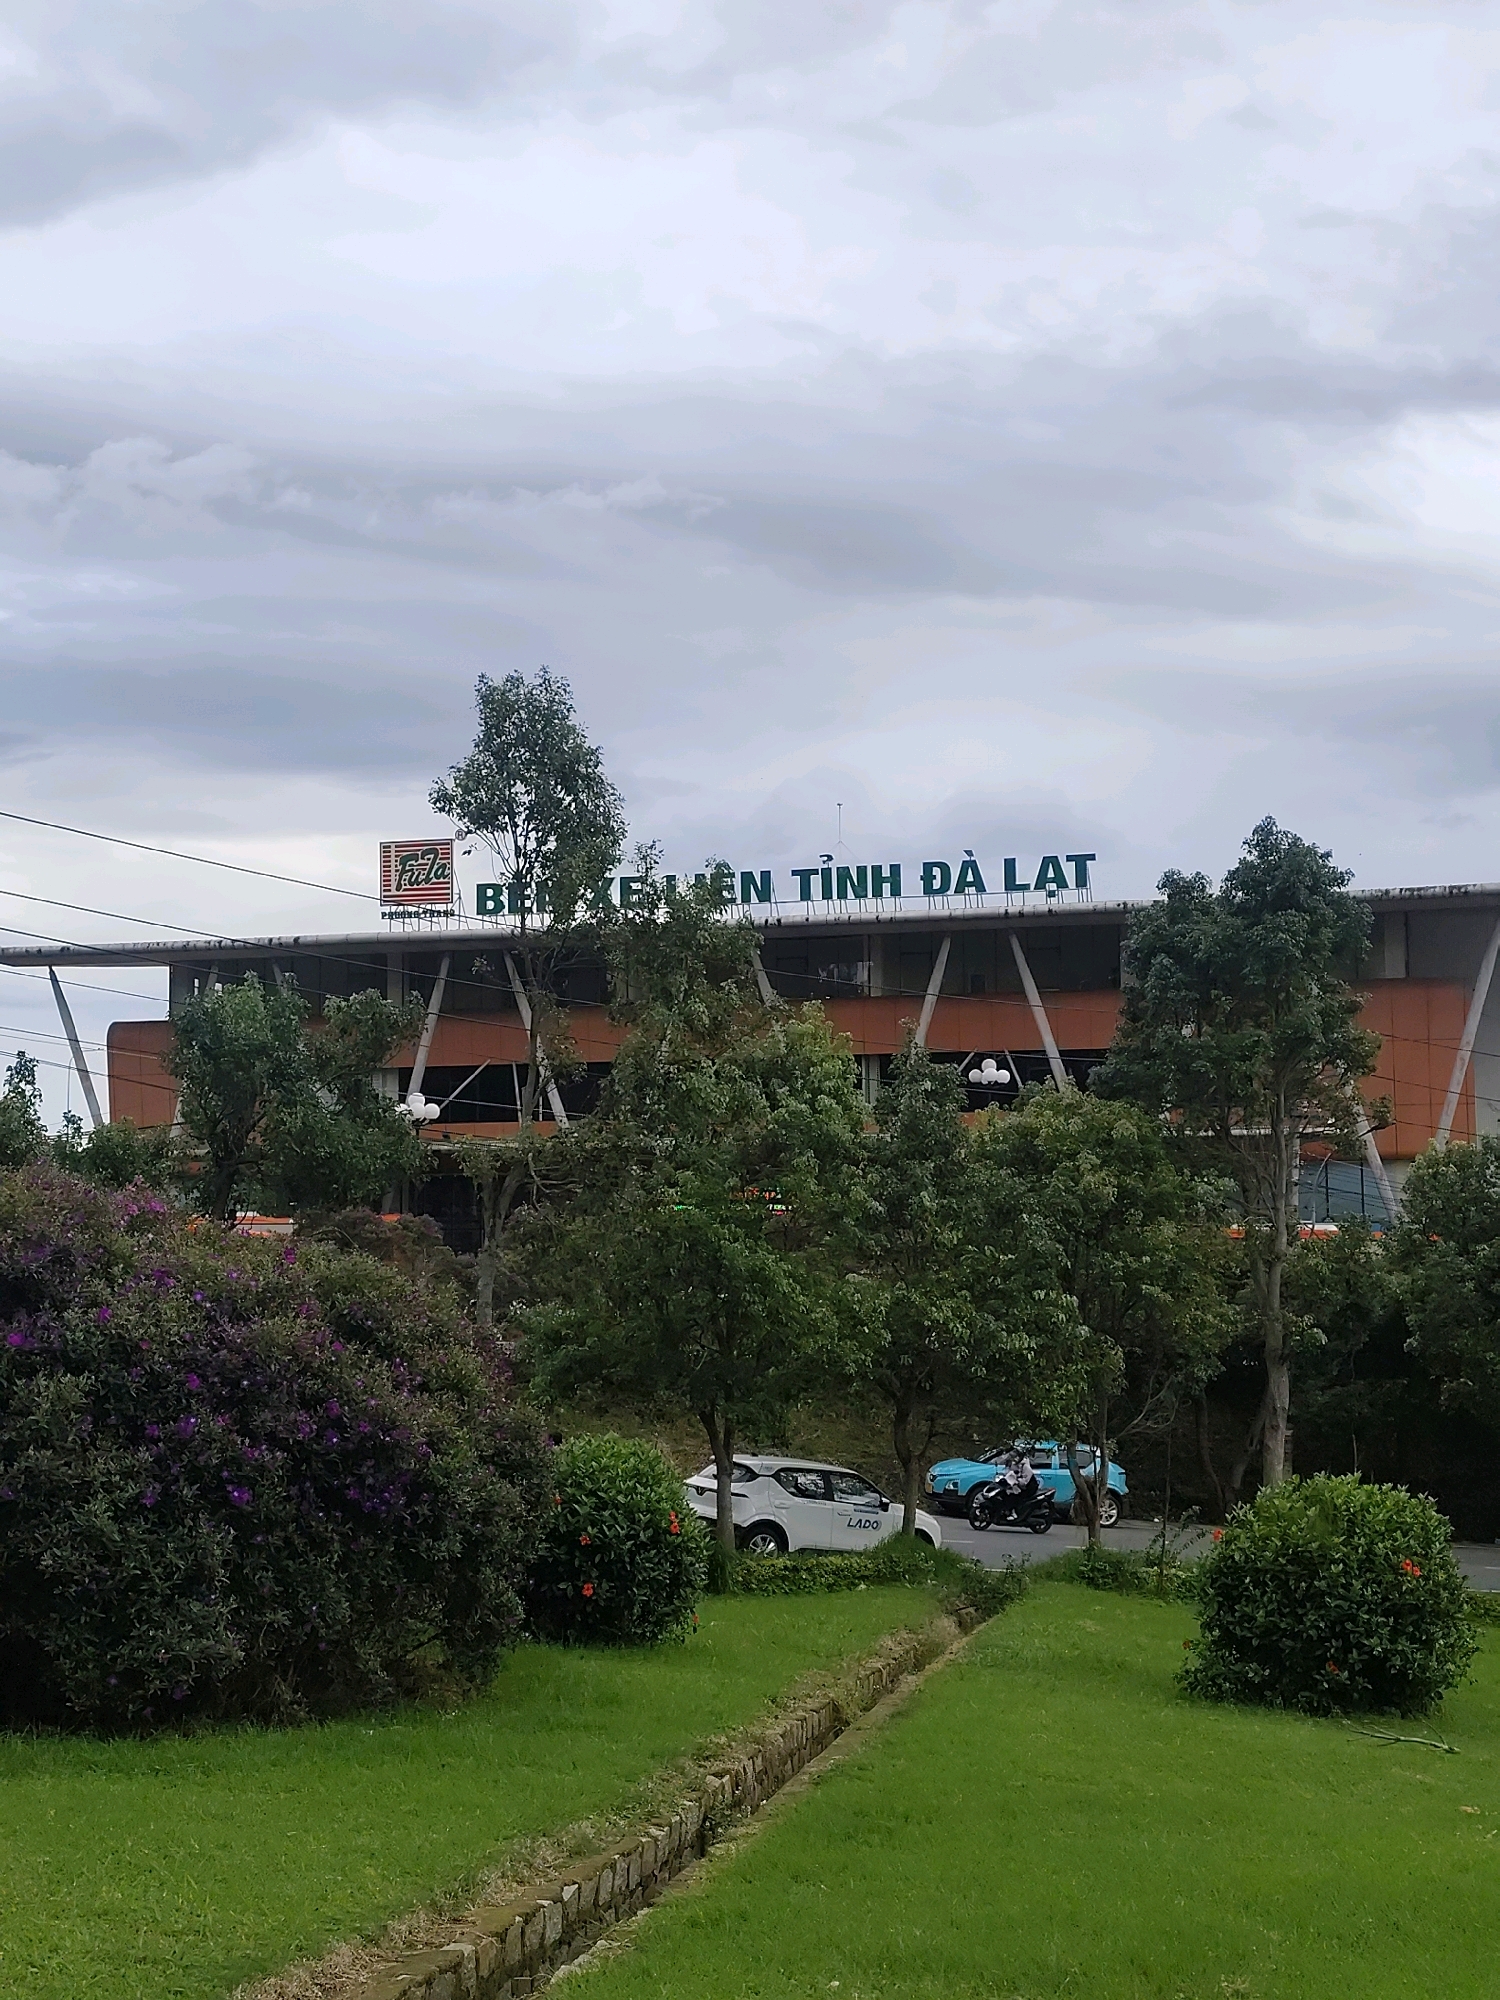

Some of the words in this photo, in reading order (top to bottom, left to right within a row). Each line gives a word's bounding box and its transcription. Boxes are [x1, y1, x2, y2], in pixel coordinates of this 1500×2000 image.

[791, 854, 902, 901] TỈNH
[920, 849, 987, 895] ĐÀ
[1003, 853, 1096, 898] LẠT
[847, 1517, 880, 1530] LADO
